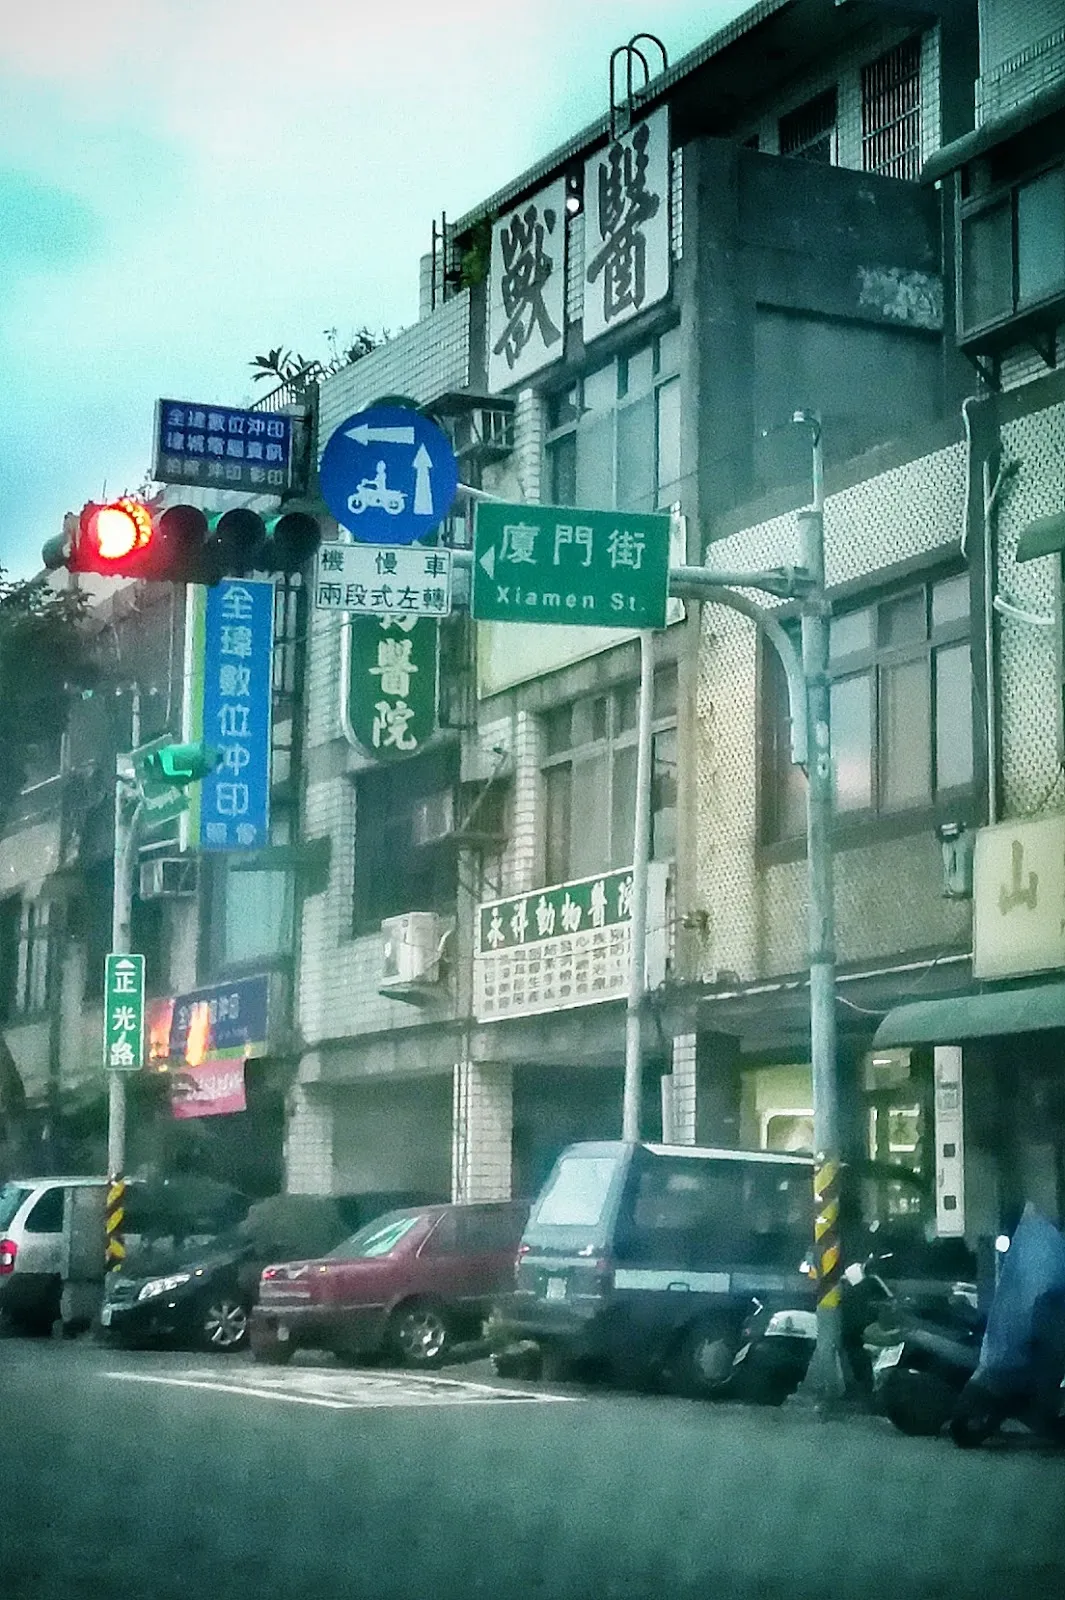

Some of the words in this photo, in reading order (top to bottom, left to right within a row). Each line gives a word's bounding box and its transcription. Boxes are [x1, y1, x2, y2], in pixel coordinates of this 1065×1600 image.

[499, 522, 646, 570] 廈門街
[321, 548, 448, 580] 機慢車
[318, 581, 445, 612] 兩段式左轉
[496, 585, 595, 610] Xiamen
[610, 592, 645, 612] St.
[111, 972, 137, 1067] 正光路
